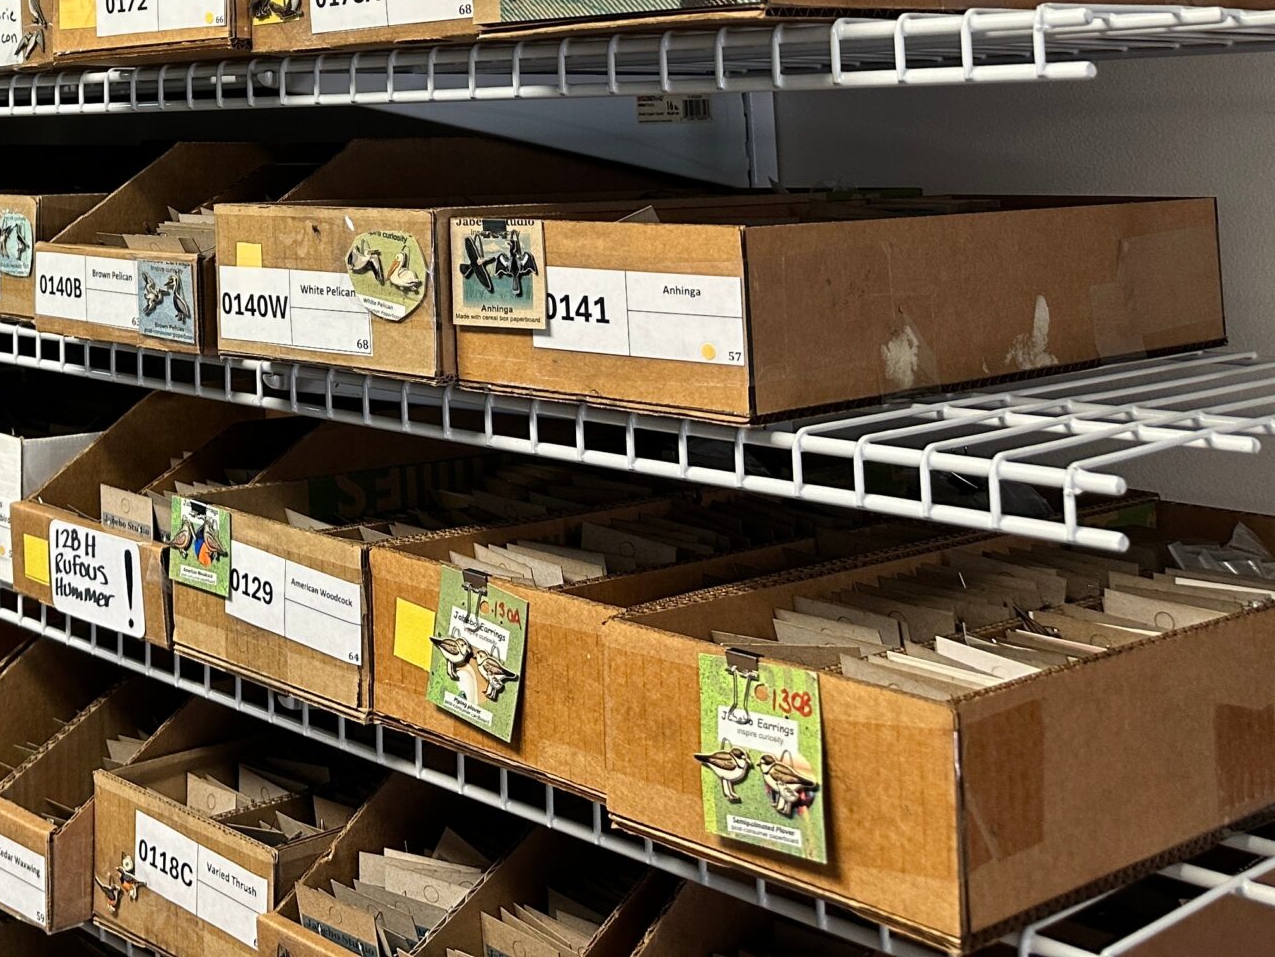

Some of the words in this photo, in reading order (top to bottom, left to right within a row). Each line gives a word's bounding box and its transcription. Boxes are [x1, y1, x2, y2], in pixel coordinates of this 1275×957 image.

[459, 4, 472, 15] 68
[215, 15, 224, 24] 66
[382, 231, 408, 245] curiosity
[92, 269, 111, 280] Brown
[111, 271, 133, 282] Pelican
[39, 274, 82, 298] 0140B
[300, 284, 325, 296] White
[326, 286, 356, 298] Pelican
[663, 285, 701, 297] Anhinga
[222, 291, 288, 319] 0140W
[481, 304, 514, 315] Anhinga
[546, 292, 610, 324] 0141
[356, 339, 369, 350] 68
[728, 351, 742, 362] 57
[85, 534, 96, 558] H
[55, 581, 116, 608] Hummer
[124, 549, 134, 629] !
[230, 568, 274, 606] 0129
[291, 578, 319, 596] American
[319, 586, 354, 608] Woodcock
[479, 624, 507, 642] Earrings
[348, 651, 360, 662] 64
[737, 727, 757, 738] inspire
[759, 733, 784, 746] curiosity
[757, 718, 795, 737] Earrings
[732, 816, 775, 834] Semipalmated
[775, 825, 796, 836] Plover
[14, 853, 41, 878] Waxwing
[138, 838, 193, 887] 0118C
[206, 861, 230, 883] Varied
[231, 874, 257, 897] Thrush
[36, 911, 45, 923] 59
